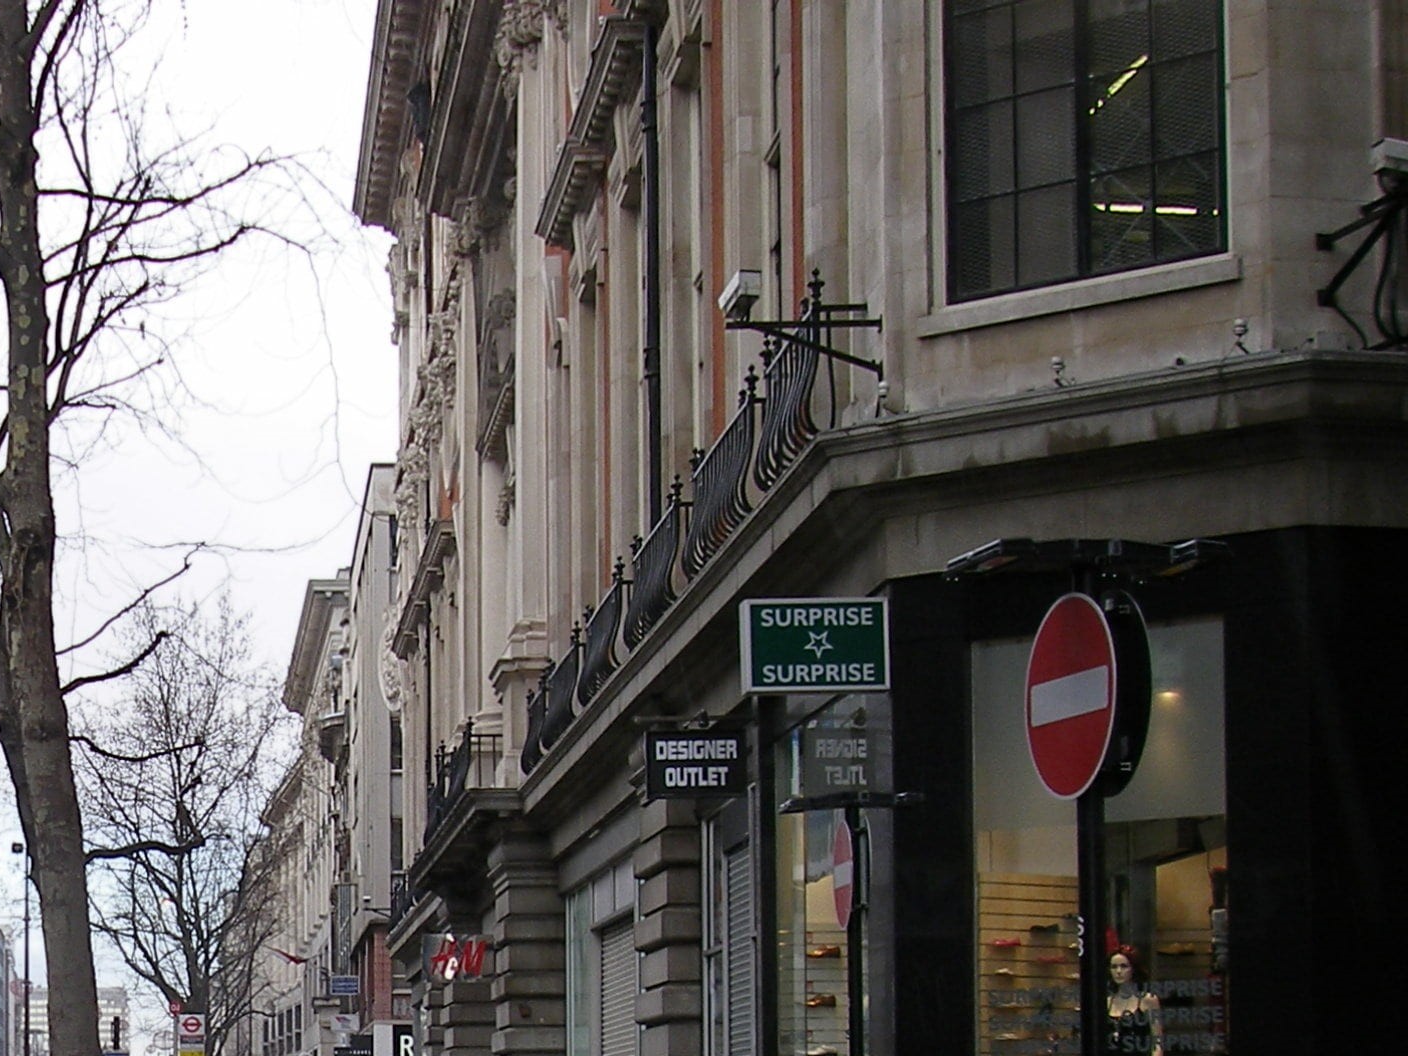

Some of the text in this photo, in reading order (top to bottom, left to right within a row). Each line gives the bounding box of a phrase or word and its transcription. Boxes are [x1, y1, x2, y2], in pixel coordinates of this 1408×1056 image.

[760, 607, 874, 627] SURPRISE
[762, 663, 875, 683] SURPRISE
[655, 739, 737, 761] DESIGNER
[665, 766, 729, 788] OUTLET
